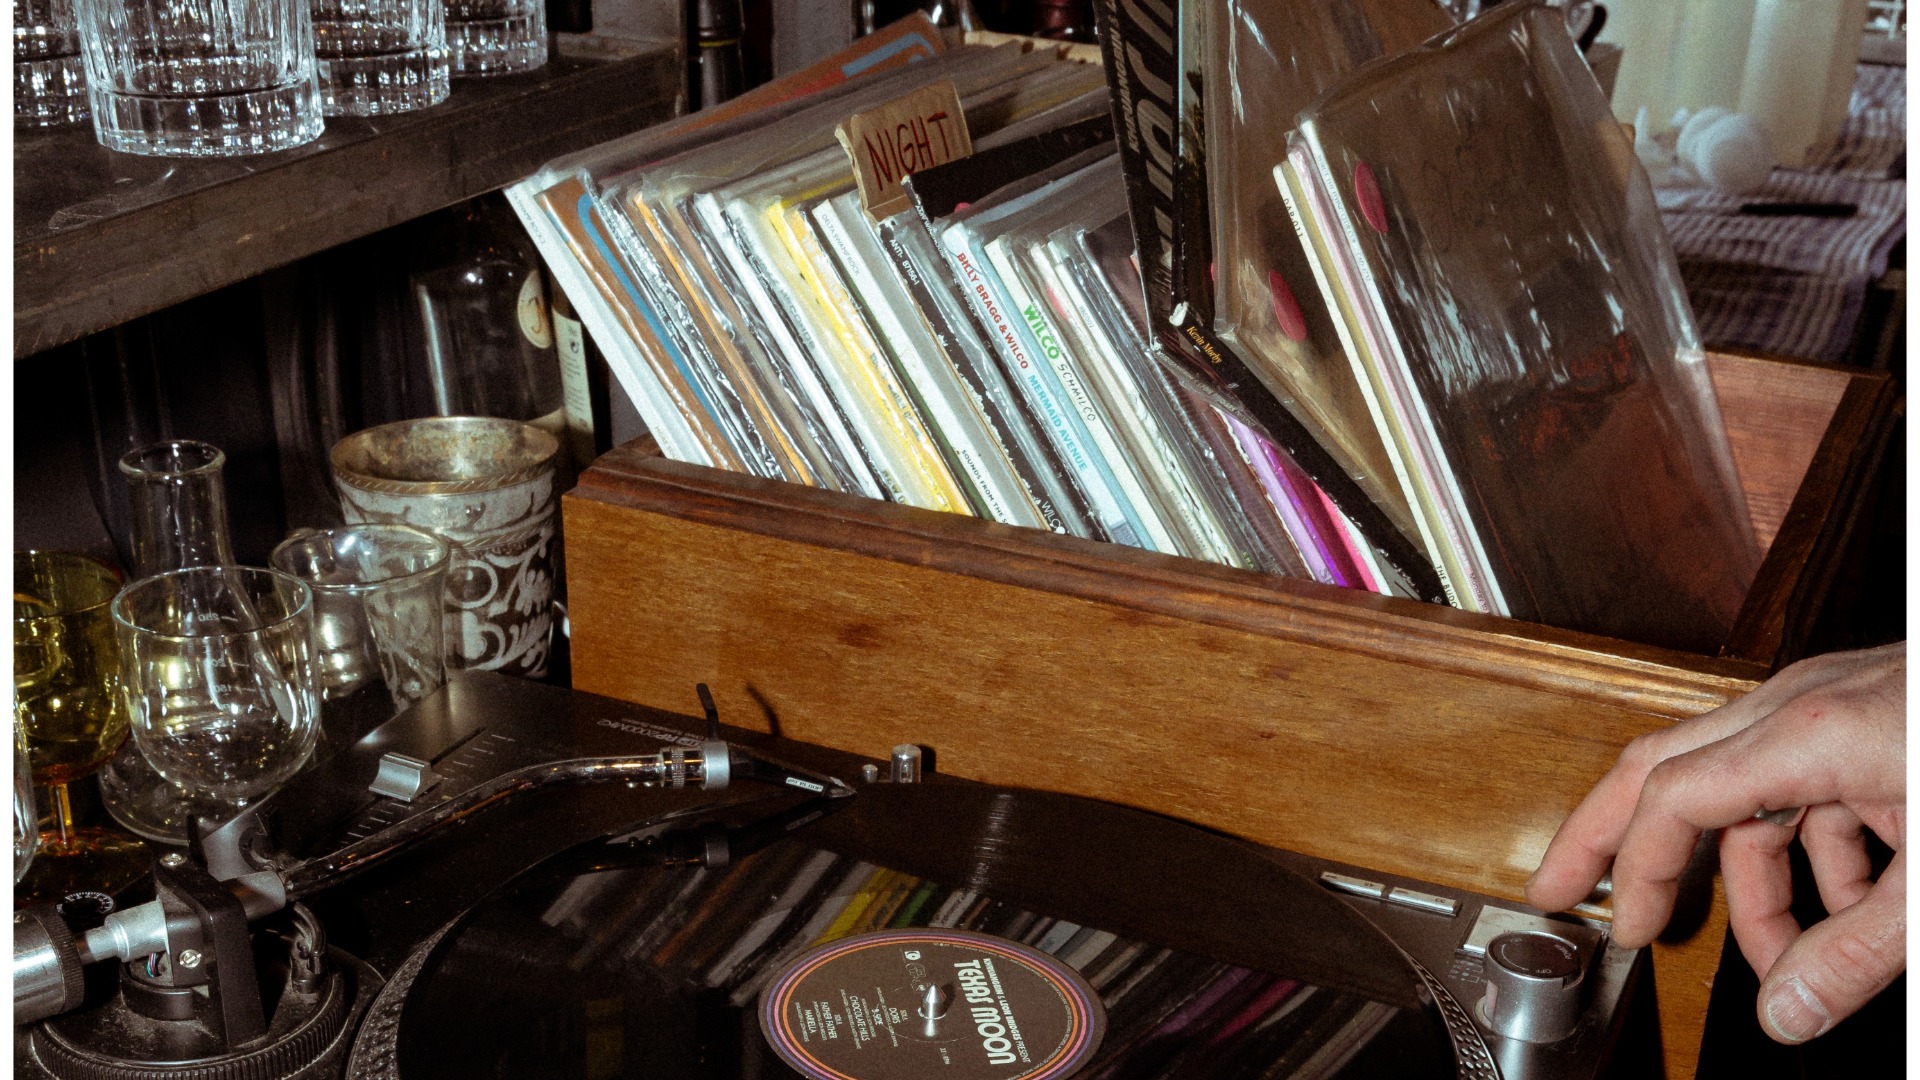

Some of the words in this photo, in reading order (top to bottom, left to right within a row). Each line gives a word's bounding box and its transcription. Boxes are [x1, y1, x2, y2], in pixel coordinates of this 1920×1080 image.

[862, 111, 949, 192] NIGHT
[820, 213, 836, 234] DELTA
[831, 232, 850, 257] SWAMP
[845, 255, 861, 276] ROCK
[889, 238, 904, 258] ANTI-
[957, 252, 976, 282] BILLY
[976, 284, 1002, 323] BRAGG
[999, 323, 1008, 334] &
[1004, 334, 1029, 369] WILCO
[1027, 374, 1061, 425] MERMAID
[1058, 427, 1086, 471] AVENUE
[1022, 304, 1060, 360] WILCO
[1057, 363, 1096, 421] SCHMILCO
[1186, 324, 1206, 346] Kevin
[1201, 341, 1223, 365] Morby
[961, 449, 981, 479] SOUNDS
[979, 480, 994, 501] FROM
[992, 502, 1003, 517] THE
[1435, 565, 1446, 580] THE
[1468, 572, 1484, 602] Monday
[954, 959, 994, 1004] TEXAS
[970, 1007, 1017, 1065] MOON
[1005, 1014, 1023, 1042] BRIDGES
